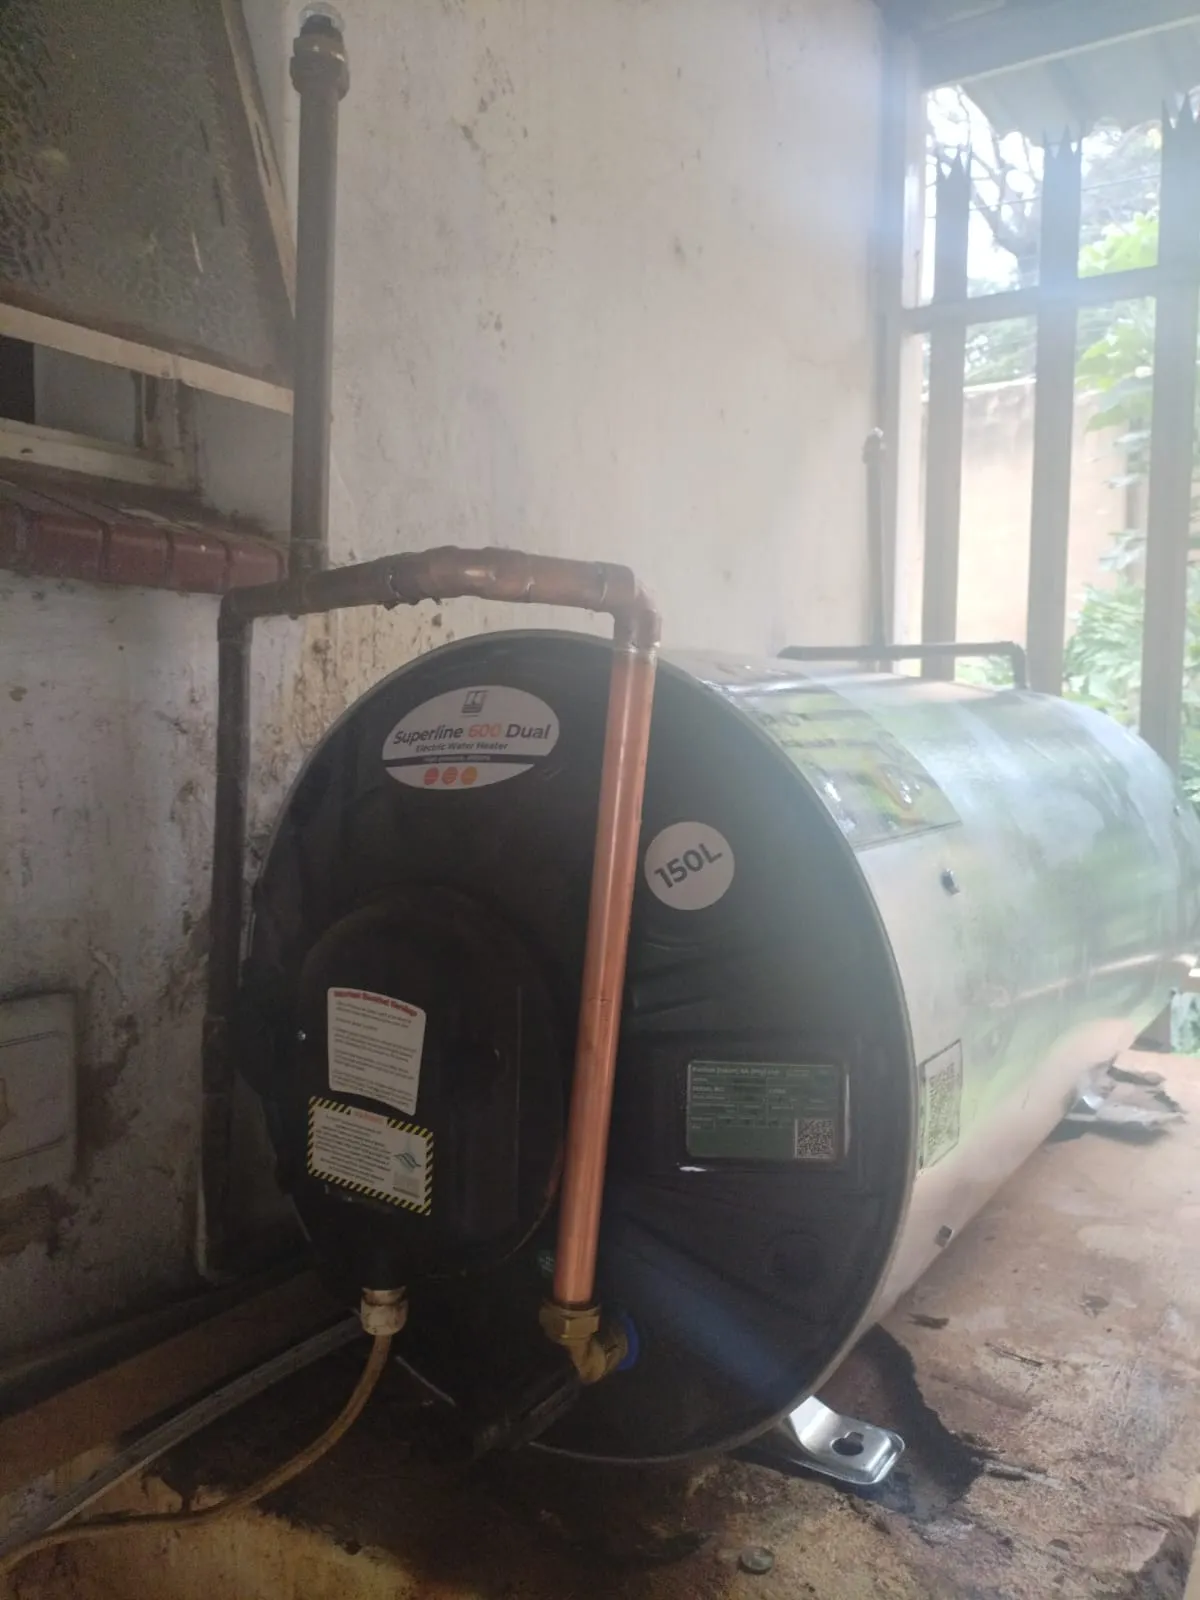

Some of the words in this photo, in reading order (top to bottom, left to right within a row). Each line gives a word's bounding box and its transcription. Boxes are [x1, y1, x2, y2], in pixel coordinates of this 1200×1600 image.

[393, 725, 463, 746] Superline
[468, 724, 501, 737] 600
[505, 724, 551, 739] Dual
[415, 744, 446, 753] Electric
[447, 742, 474, 751] Water
[476, 742, 508, 751] Heater
[654, 843, 722, 888] 150L
